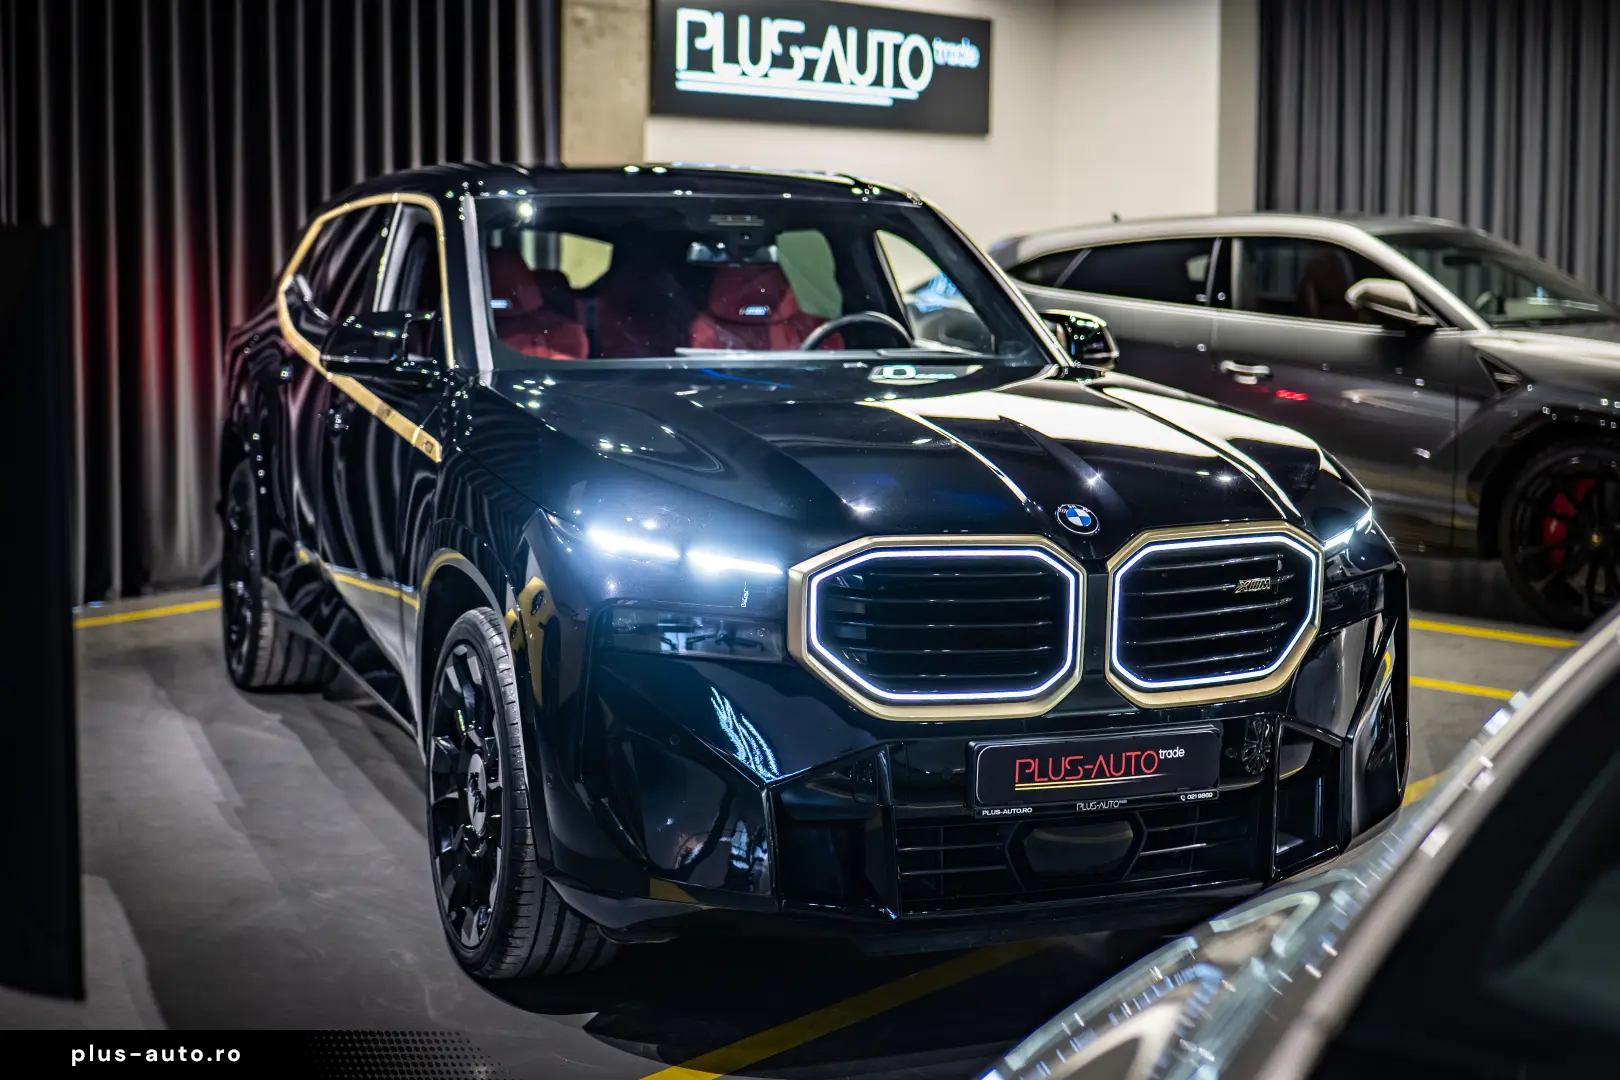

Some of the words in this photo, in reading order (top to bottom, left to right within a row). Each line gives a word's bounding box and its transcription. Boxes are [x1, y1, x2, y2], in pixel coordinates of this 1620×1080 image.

[676, 8, 934, 92] PLUS-AUTO
[1015, 750, 1159, 783] PLUS-AUTO
[1159, 746, 1185, 759] trade
[982, 807, 1033, 816] PLUS-AUTO.RO
[1076, 800, 1120, 811] PLUS-AUTO
